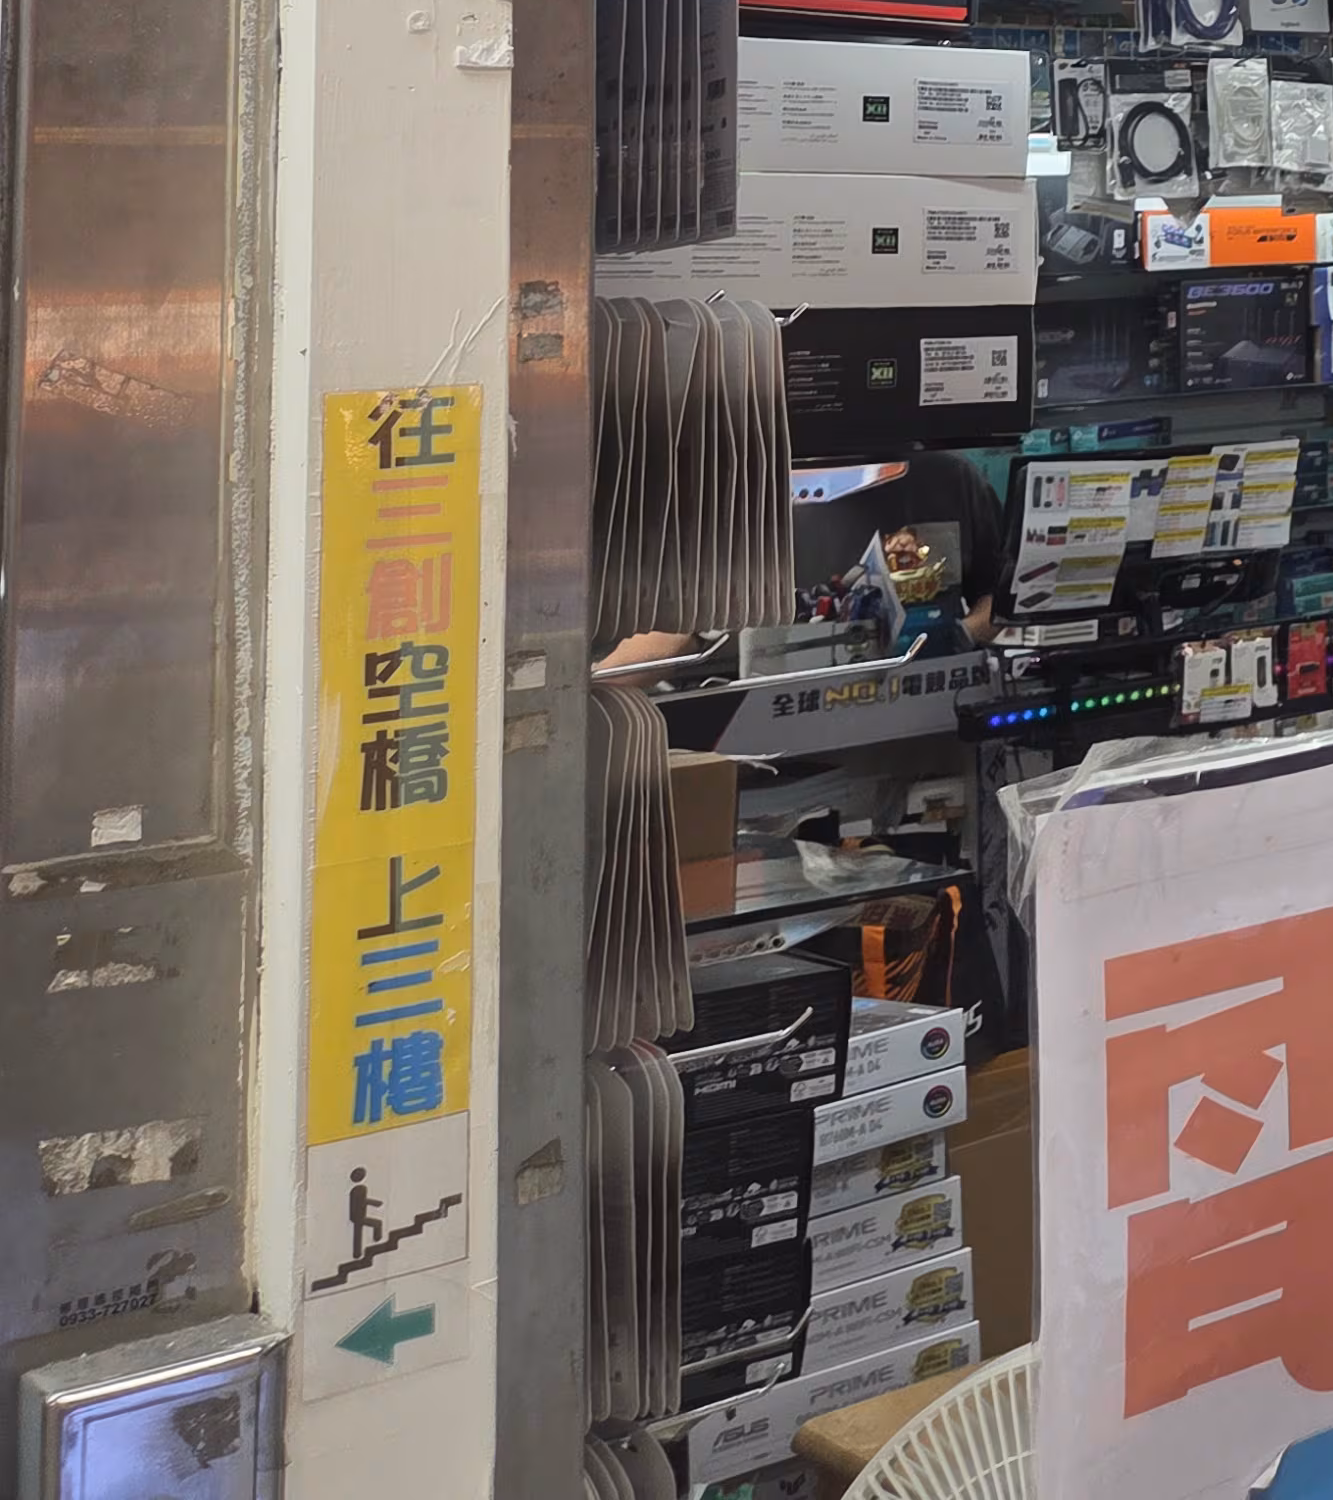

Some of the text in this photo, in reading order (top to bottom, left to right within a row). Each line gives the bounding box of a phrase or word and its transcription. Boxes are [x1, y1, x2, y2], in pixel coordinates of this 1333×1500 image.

[352, 392, 455, 1125] 往三創空橋 上三樓
[810, 1364, 894, 1405] PRIME
